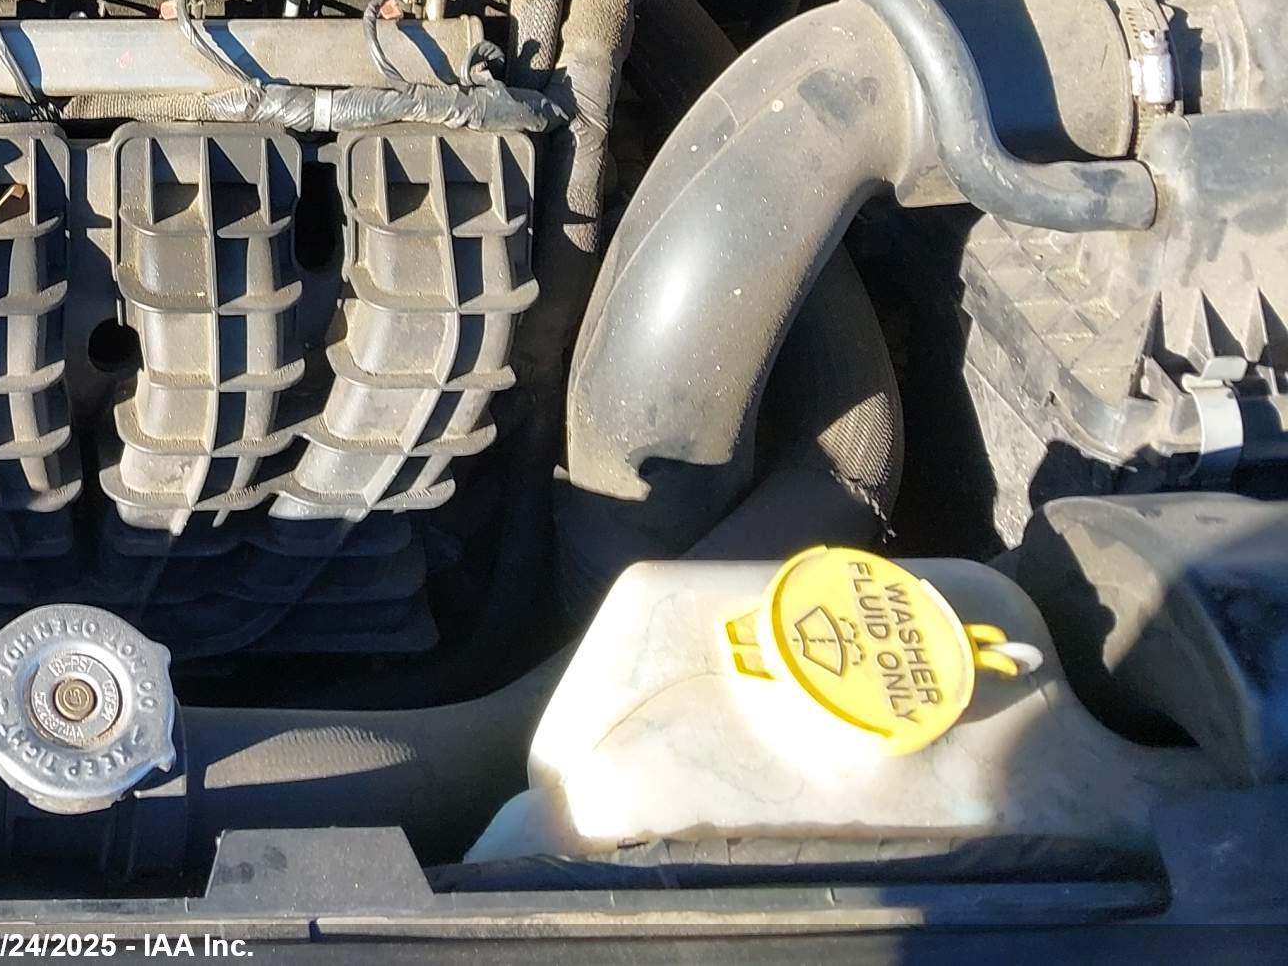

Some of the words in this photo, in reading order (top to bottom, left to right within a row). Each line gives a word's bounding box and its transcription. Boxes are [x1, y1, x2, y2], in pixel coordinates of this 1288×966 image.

[33, 617, 99, 641] OPEN
[849, 561, 891, 640] FLUID
[876, 651, 920, 723] ONLY
[885, 583, 943, 705] WASHER
[67, 747, 131, 777] KEEP
